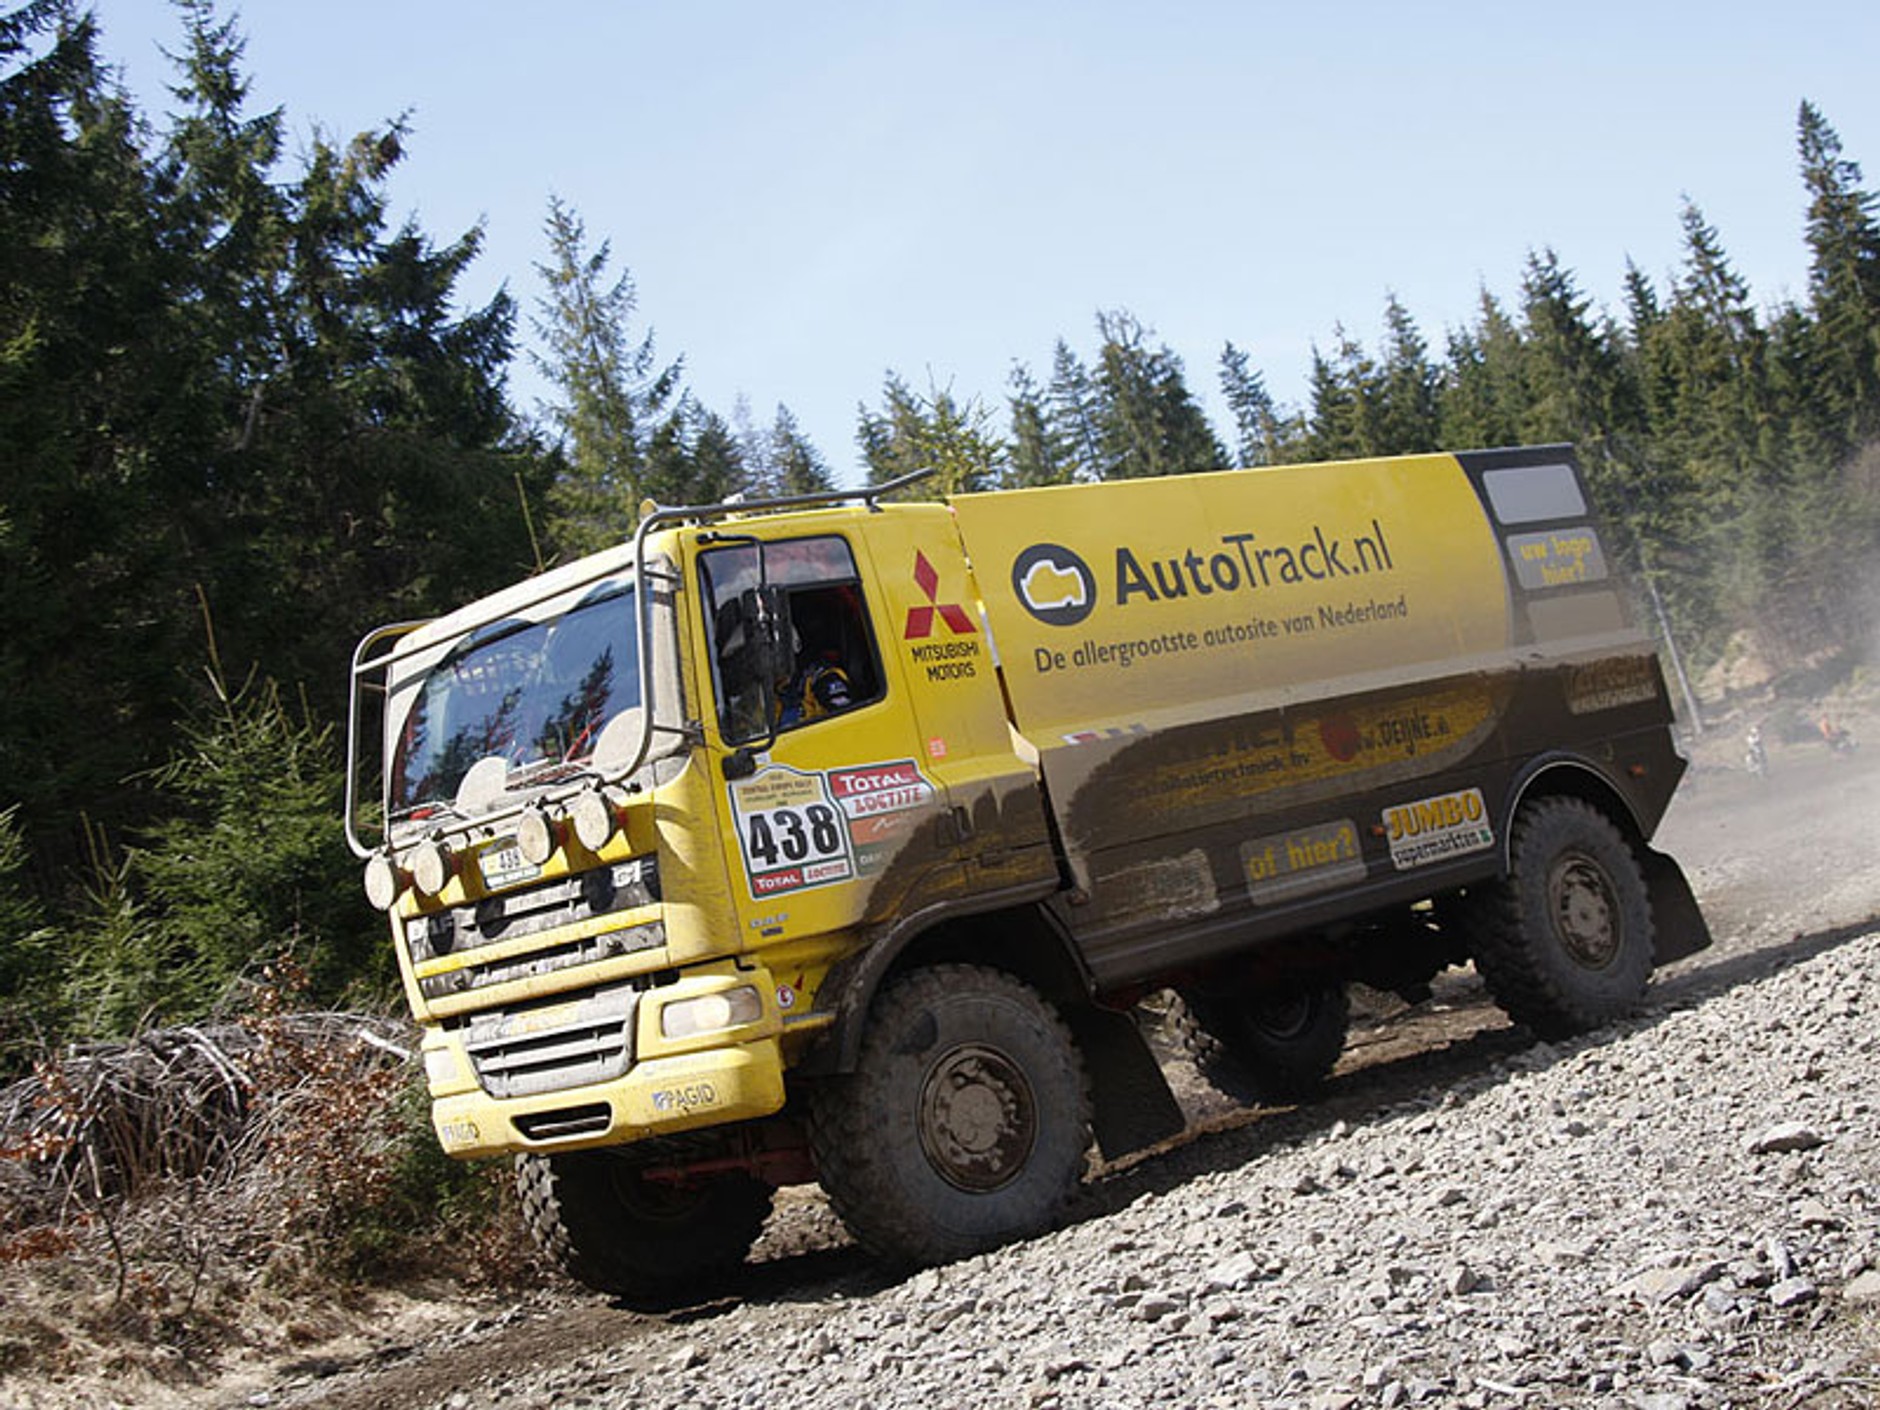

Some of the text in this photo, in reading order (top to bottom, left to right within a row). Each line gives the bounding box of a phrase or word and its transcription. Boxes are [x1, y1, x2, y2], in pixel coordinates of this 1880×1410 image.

[1115, 519, 1394, 606] AutoTrack.nl
[1034, 595, 1408, 673] De allergrootste autosite van Nederland
[911, 641, 979, 663] MITSUBISHI
[926, 661, 977, 682] MOTORS
[838, 773, 912, 793] TOTAL
[853, 788, 923, 814] LOCTITE
[1391, 792, 1483, 841] JUMBO
[750, 804, 840, 866] 438
[1395, 831, 1481, 865] supermarkten
[500, 848, 521, 869] 438
[1285, 827, 1355, 871] hier?
[756, 873, 799, 890] TOTAL
[664, 1084, 715, 1108] PAGID
